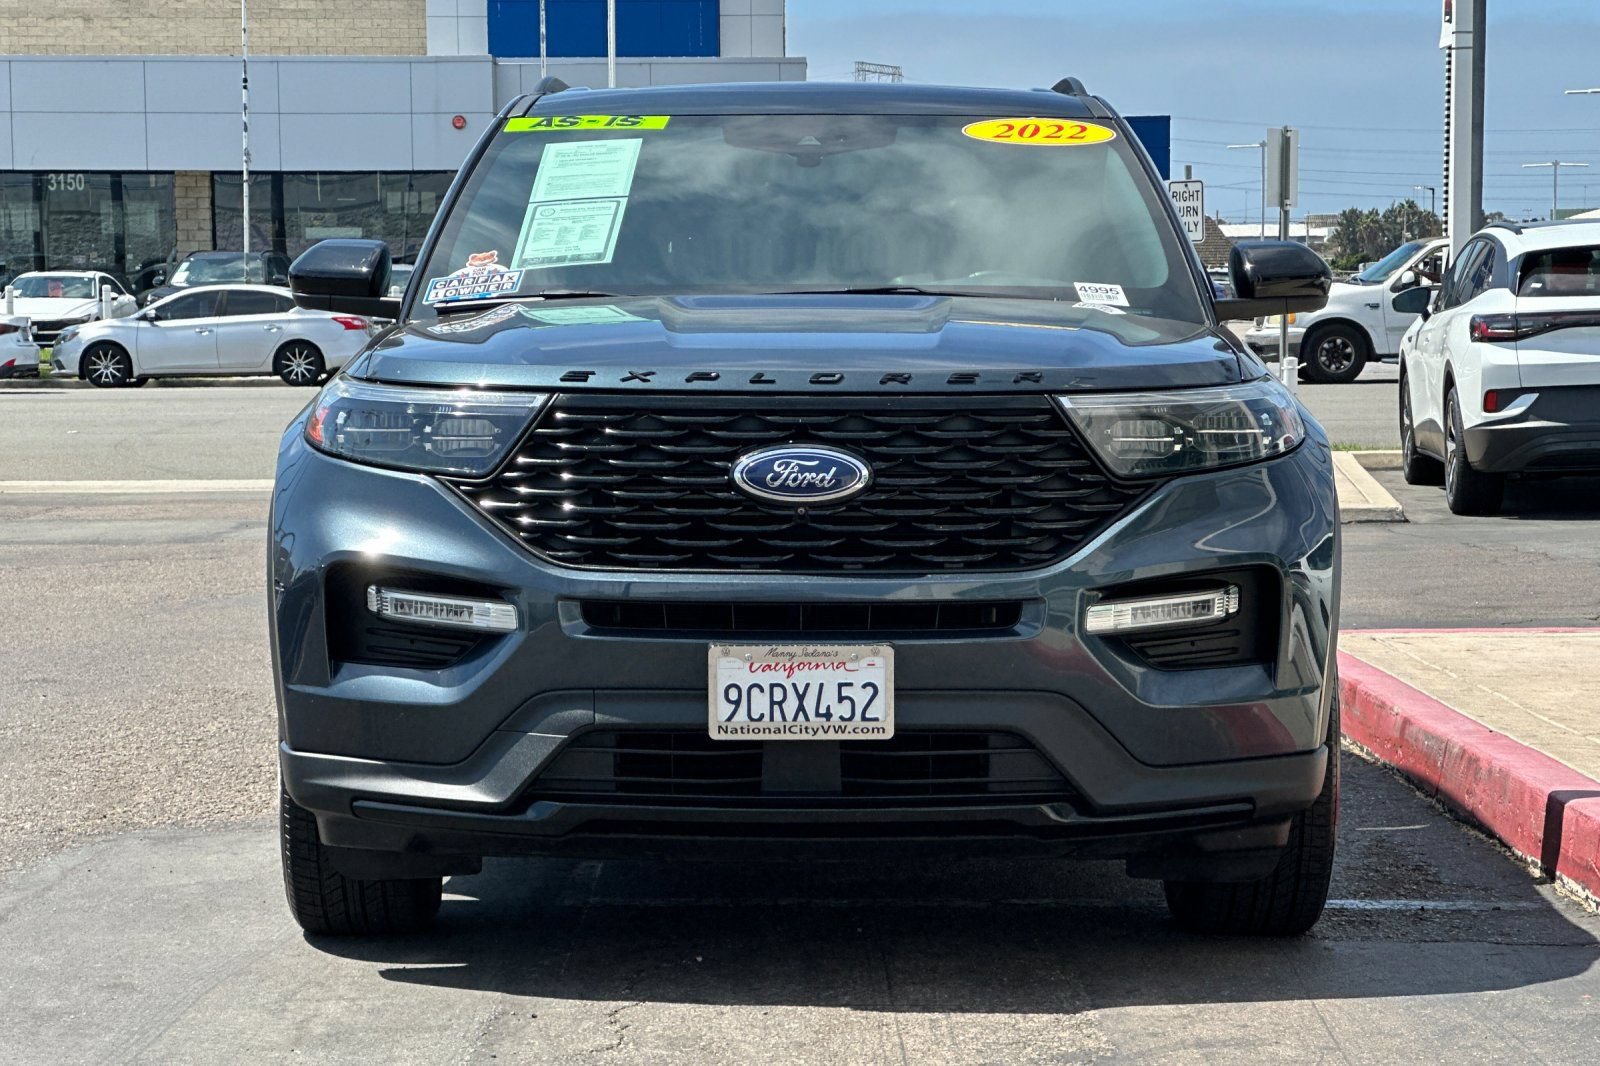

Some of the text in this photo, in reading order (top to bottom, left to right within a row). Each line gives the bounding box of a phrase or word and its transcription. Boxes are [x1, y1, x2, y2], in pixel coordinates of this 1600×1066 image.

[994, 123, 1088, 140] 2022
[47, 173, 85, 191] 3150
[1171, 190, 1200, 202] RIGHT
[1178, 205, 1199, 217] URN
[434, 275, 515, 289] CARFAX
[445, 282, 513, 297] OWNER
[1079, 285, 1120, 295] 4995
[559, 370, 1042, 385] EXPLORER
[765, 458, 838, 488] Ford
[764, 647, 797, 662] Manny
[723, 682, 881, 723] 9CRX452
[716, 724, 887, 737] NationalCityVW.com
